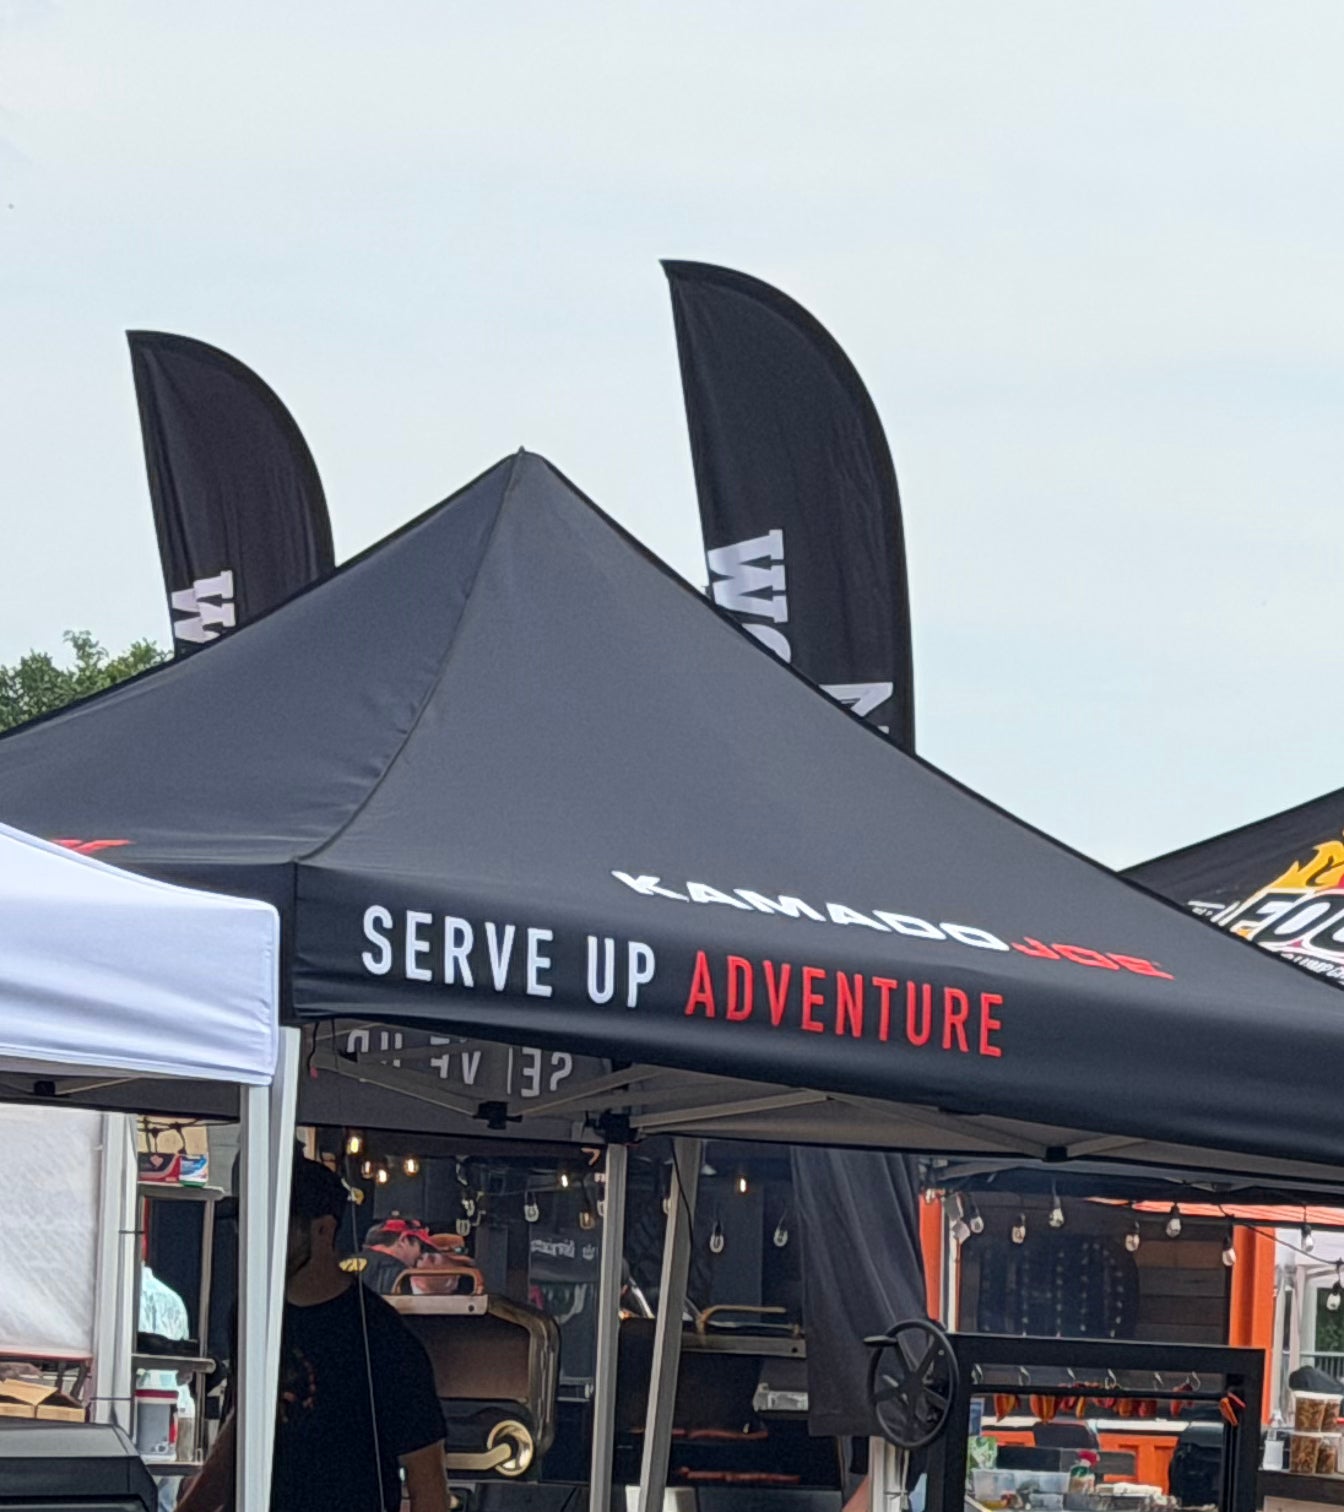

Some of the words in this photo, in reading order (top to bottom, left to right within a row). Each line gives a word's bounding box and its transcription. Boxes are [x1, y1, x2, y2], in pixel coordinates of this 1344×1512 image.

[612, 870, 1010, 951] KAMADO
[362, 905, 553, 998] SERVE
[587, 936, 657, 1008] UP
[684, 950, 1004, 1057] ADVENTURE
